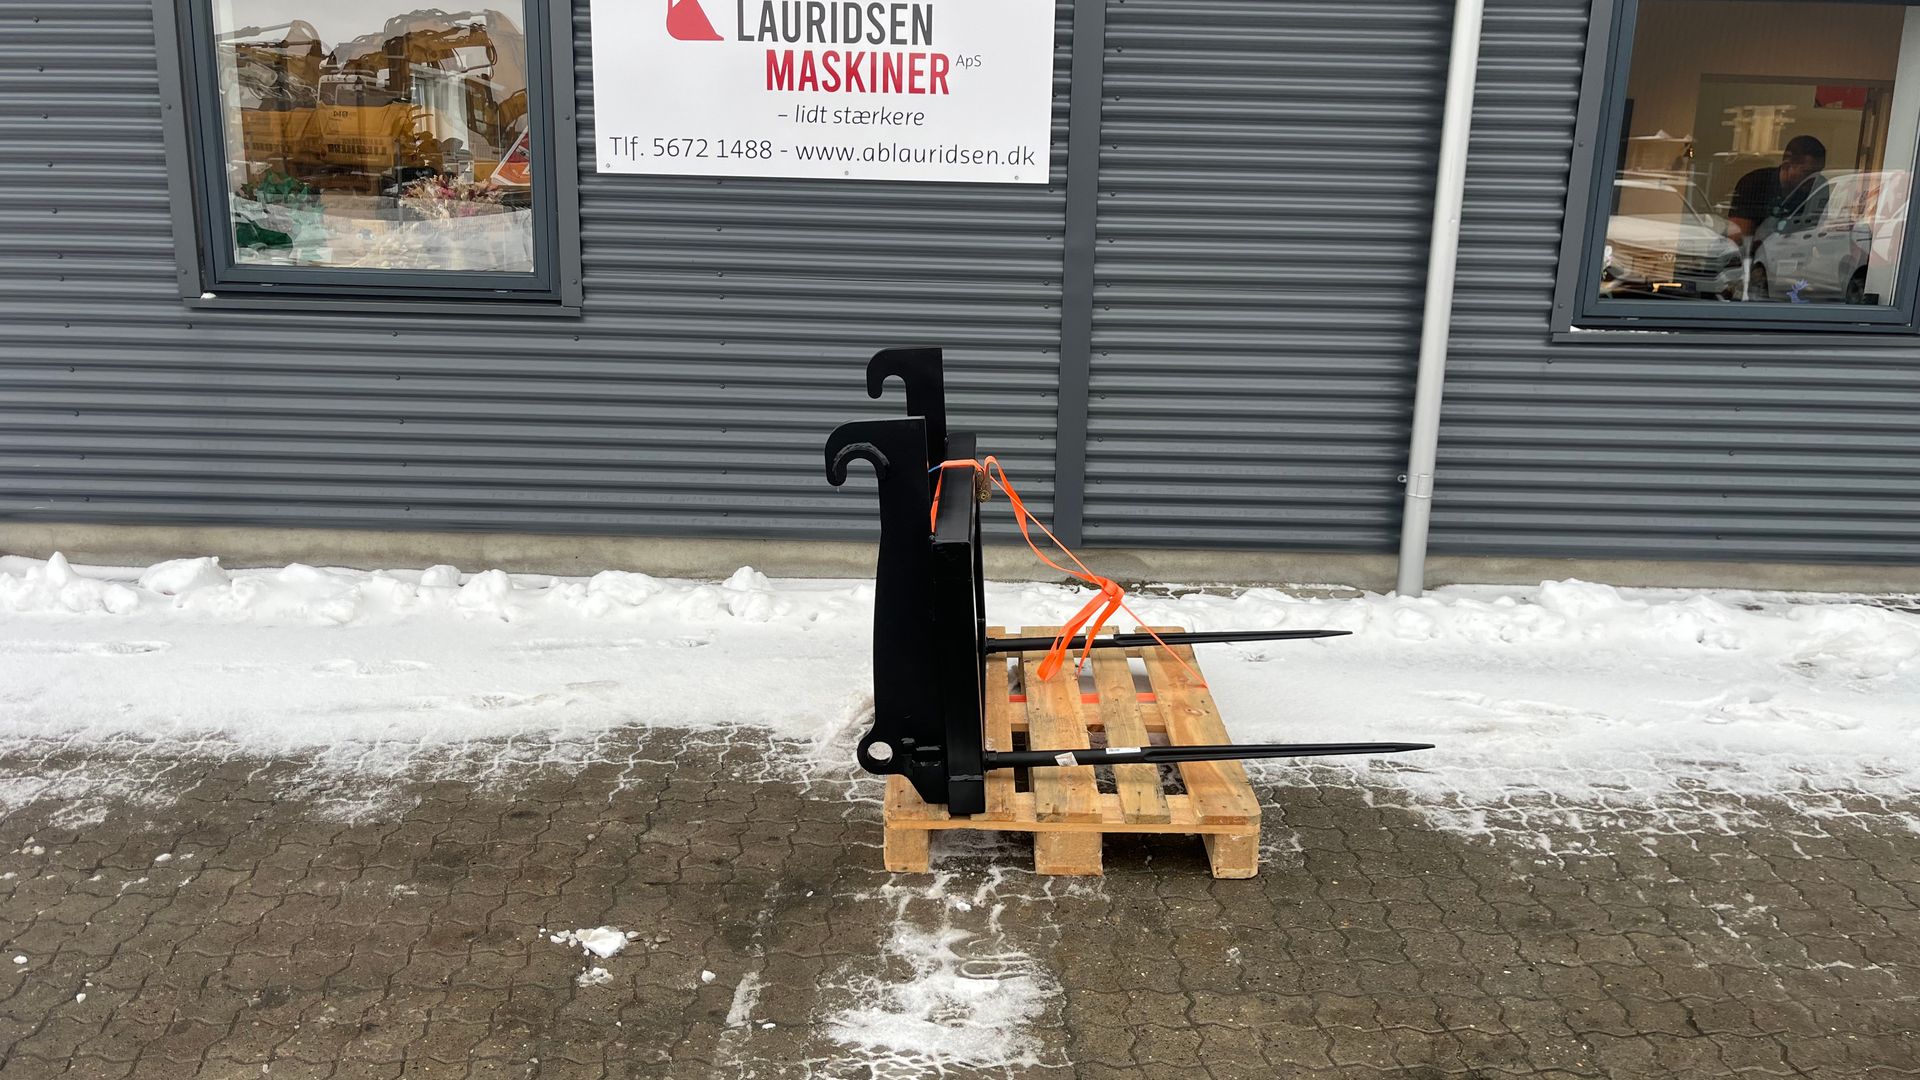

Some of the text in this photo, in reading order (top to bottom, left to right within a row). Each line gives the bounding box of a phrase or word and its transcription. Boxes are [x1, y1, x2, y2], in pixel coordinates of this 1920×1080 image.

[737, 0, 933, 46] LAURIDSEN
[766, 48, 982, 95] MASKINER ApS
[795, 104, 828, 124] lidt
[832, 105, 926, 126] stærkere
[609, 135, 644, 162] Tlf.
[653, 137, 709, 158] 5672
[716, 139, 773, 160] 1488
[795, 142, 1036, 166] www.ablauridsen.dk
